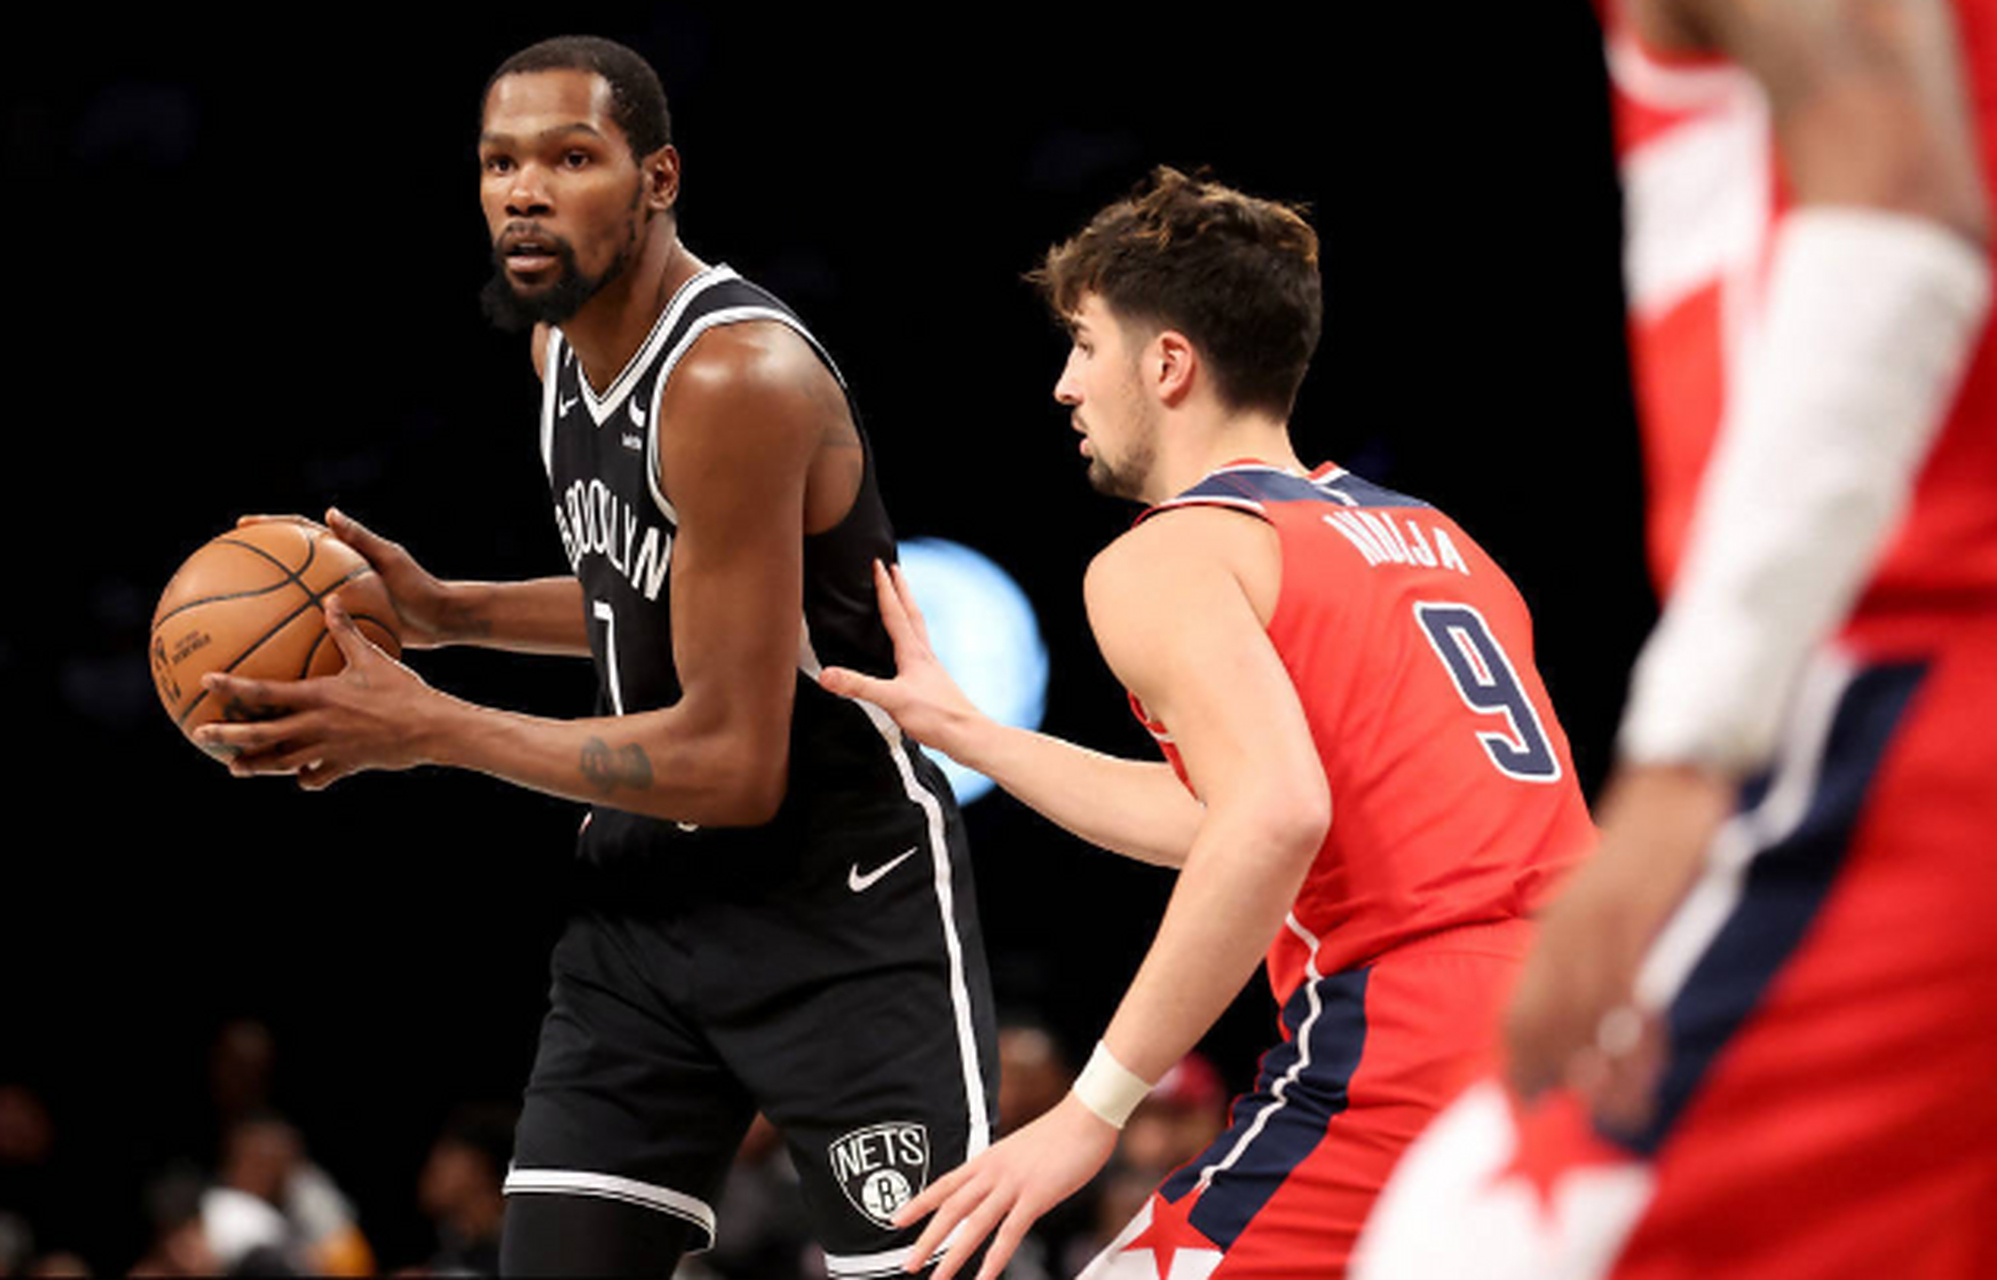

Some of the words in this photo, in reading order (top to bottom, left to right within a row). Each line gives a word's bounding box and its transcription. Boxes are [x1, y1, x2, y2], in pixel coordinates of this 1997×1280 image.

[593, 600, 624, 717] 7
[1412, 600, 1562, 784] 9
[836, 1128, 924, 1182] NETS
[876, 1177, 899, 1215] B
